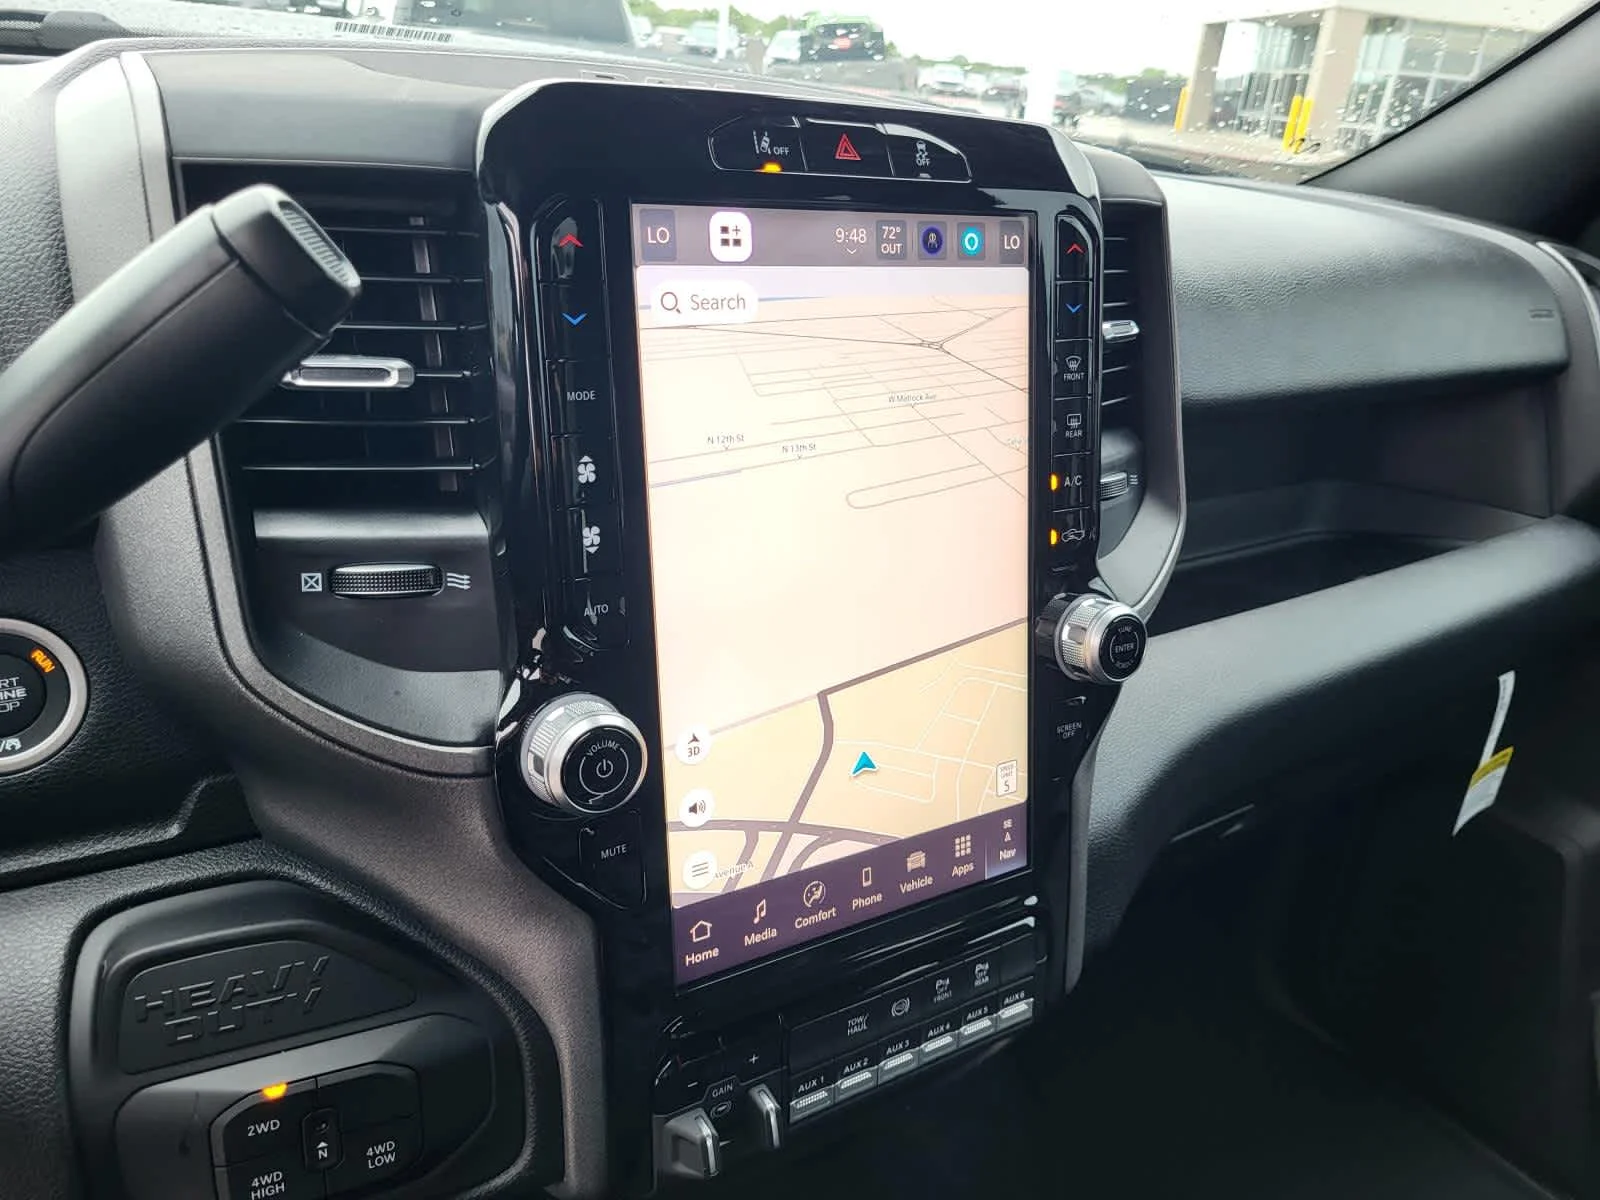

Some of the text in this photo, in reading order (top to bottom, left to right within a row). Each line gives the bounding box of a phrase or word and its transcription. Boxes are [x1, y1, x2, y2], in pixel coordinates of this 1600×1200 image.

[773, 146, 790, 156] OFF
[915, 158, 931, 167] OFF
[647, 226, 670, 244] LO
[835, 227, 867, 244] 9:48
[882, 225, 901, 240] 72°
[881, 243, 903, 255] OUT
[1003, 234, 1021, 250] LO
[690, 293, 746, 311] Search
[1063, 371, 1085, 381] FRONT
[566, 390, 597, 401] MODE
[707, 433, 745, 445] N 12th St
[1065, 429, 1083, 438] REAR
[790, 443, 808, 453] 13th
[808, 442, 817, 451] St
[1064, 474, 1083, 487] A/C
[584, 604, 609, 617] AUTO
[1114, 642, 1135, 654] ENTER
[31, 649, 56, 673] RUN
[1056, 721, 1082, 734] SCREEN
[1062, 731, 1075, 739] OFF
[585, 738, 621, 757] VOLUME
[687, 746, 700, 758] 3D
[1003, 779, 1010, 792] 5
[1003, 818, 1013, 829] SE
[600, 844, 627, 860] MUTE
[999, 848, 1017, 861] Nav
[951, 861, 975, 878] Apps
[900, 875, 934, 895] Vehicle
[852, 892, 883, 911] Phone
[794, 907, 838, 930] Comfort
[744, 927, 778, 947] Media
[684, 946, 720, 968] Home
[133, 954, 329, 1023] HEAVY
[1003, 993, 1020, 1006] AUX
[164, 986, 323, 1047] DUTY
[966, 1009, 984, 1021] AUX
[847, 1022, 868, 1036] HAUL
[927, 1025, 946, 1038] AUX
[886, 1039, 910, 1056] AUX 3
[843, 1056, 869, 1074] AUX 2
[711, 1083, 734, 1099] GAIN
[798, 1079, 818, 1093] AUX
[247, 1119, 281, 1137] 2WD
[318, 1149, 328, 1160] N
[366, 1140, 396, 1158] 4WD
[367, 1152, 396, 1169] LOW
[251, 1170, 283, 1189] 4WD
[250, 1181, 286, 1200] HIGH
